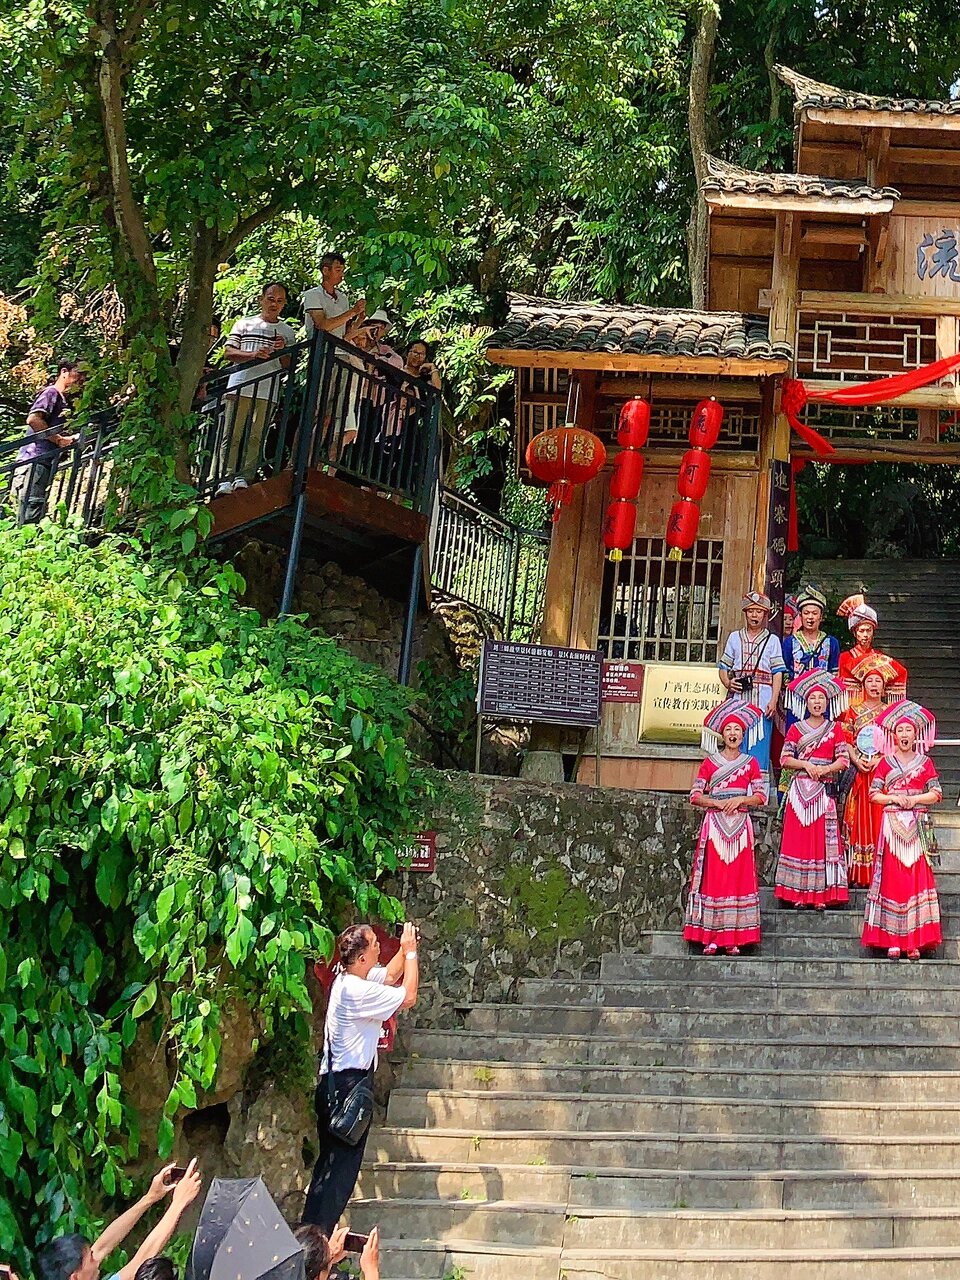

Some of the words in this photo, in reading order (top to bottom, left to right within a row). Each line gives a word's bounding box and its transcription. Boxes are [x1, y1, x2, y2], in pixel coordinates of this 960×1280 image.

[663, 681, 721, 695] 广西生态环境
[653, 697, 724, 711] 宣传教育实践基
